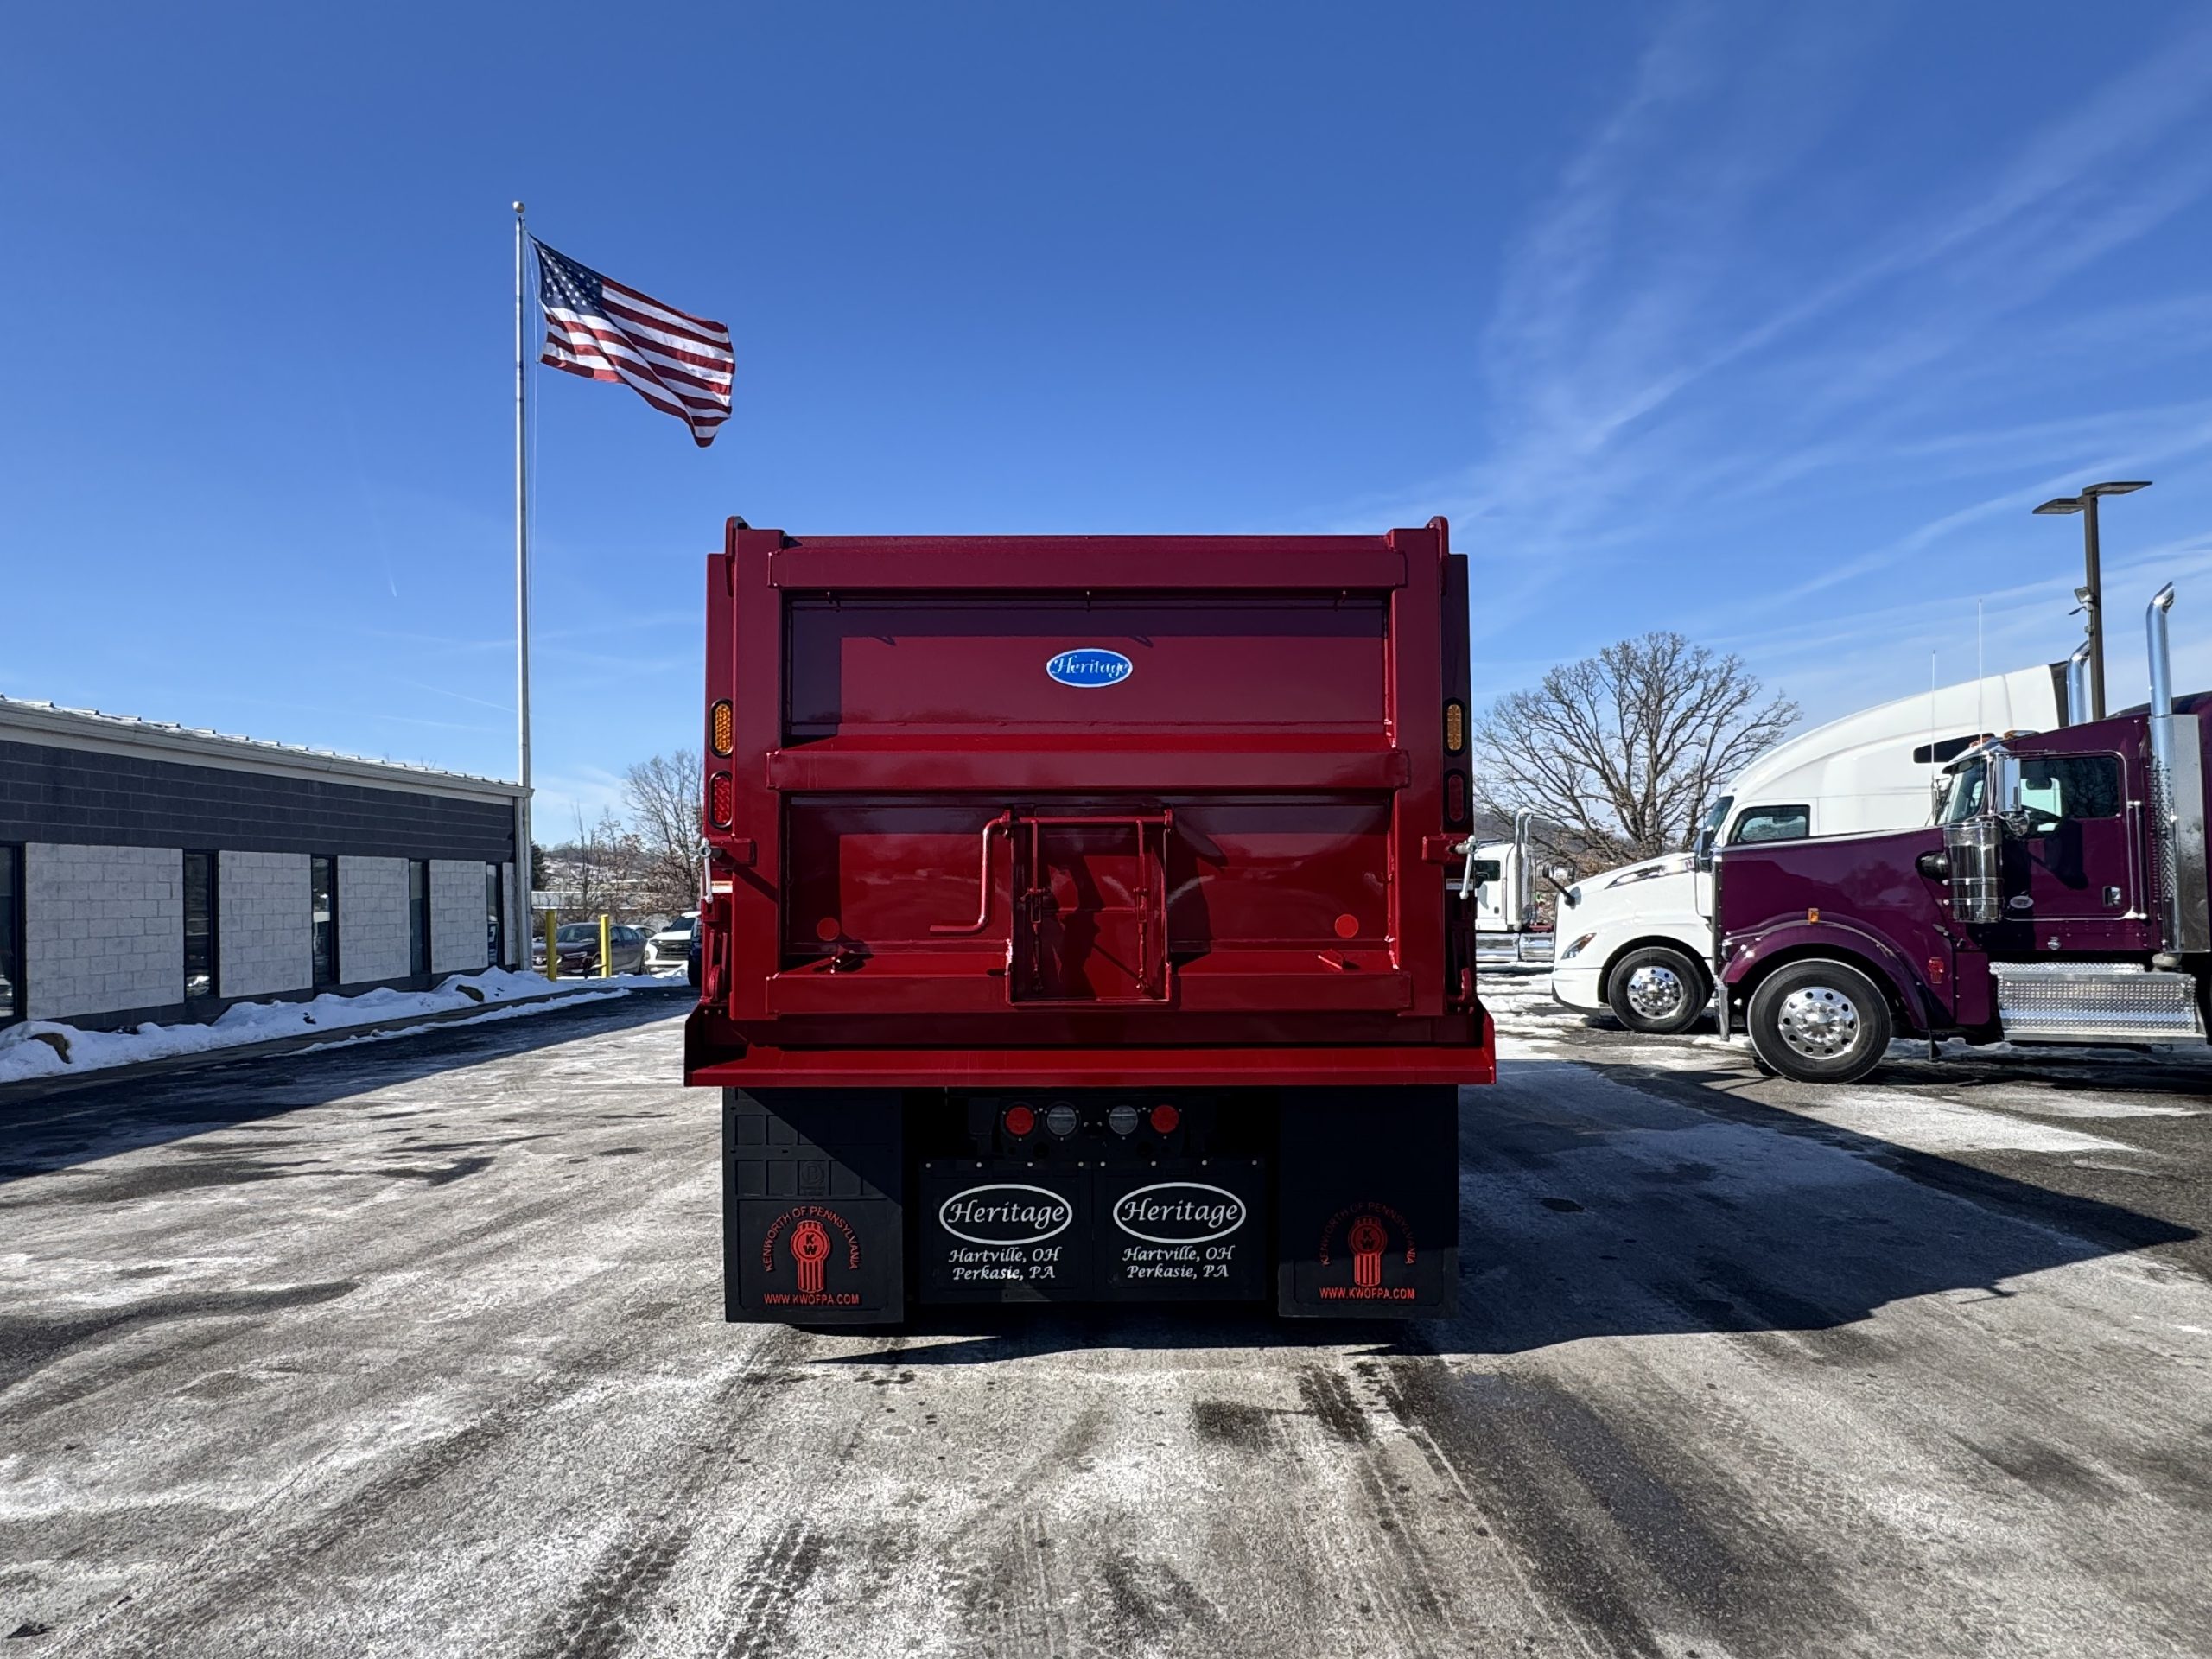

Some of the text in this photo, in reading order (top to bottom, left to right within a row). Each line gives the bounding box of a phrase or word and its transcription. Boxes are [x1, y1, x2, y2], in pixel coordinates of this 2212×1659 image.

[1052, 655, 1128, 678] Heritage
[947, 1199, 1065, 1230] Heritage
[1121, 1198, 1238, 1229] Heritage
[762, 1206, 861, 1272] KENWORTH OF PENNSYLVANIA
[805, 1234, 815, 1244] K
[1319, 1208, 1349, 1266] KENWORTH
[1350, 1202, 1364, 1214] OF
[1363, 1228, 1372, 1240] K
[803, 1244, 818, 1255] W
[948, 1246, 1063, 1263] Hartville, OH
[1122, 1244, 1236, 1262] Hartville, OH
[952, 1265, 1056, 1281] Perkasie, PA
[1127, 1263, 1230, 1279] Perkasie, PA
[764, 1294, 860, 1306] WWW.KWOFPA.COM
[1319, 1287, 1416, 1300] WWW.KWOFPA.COM
